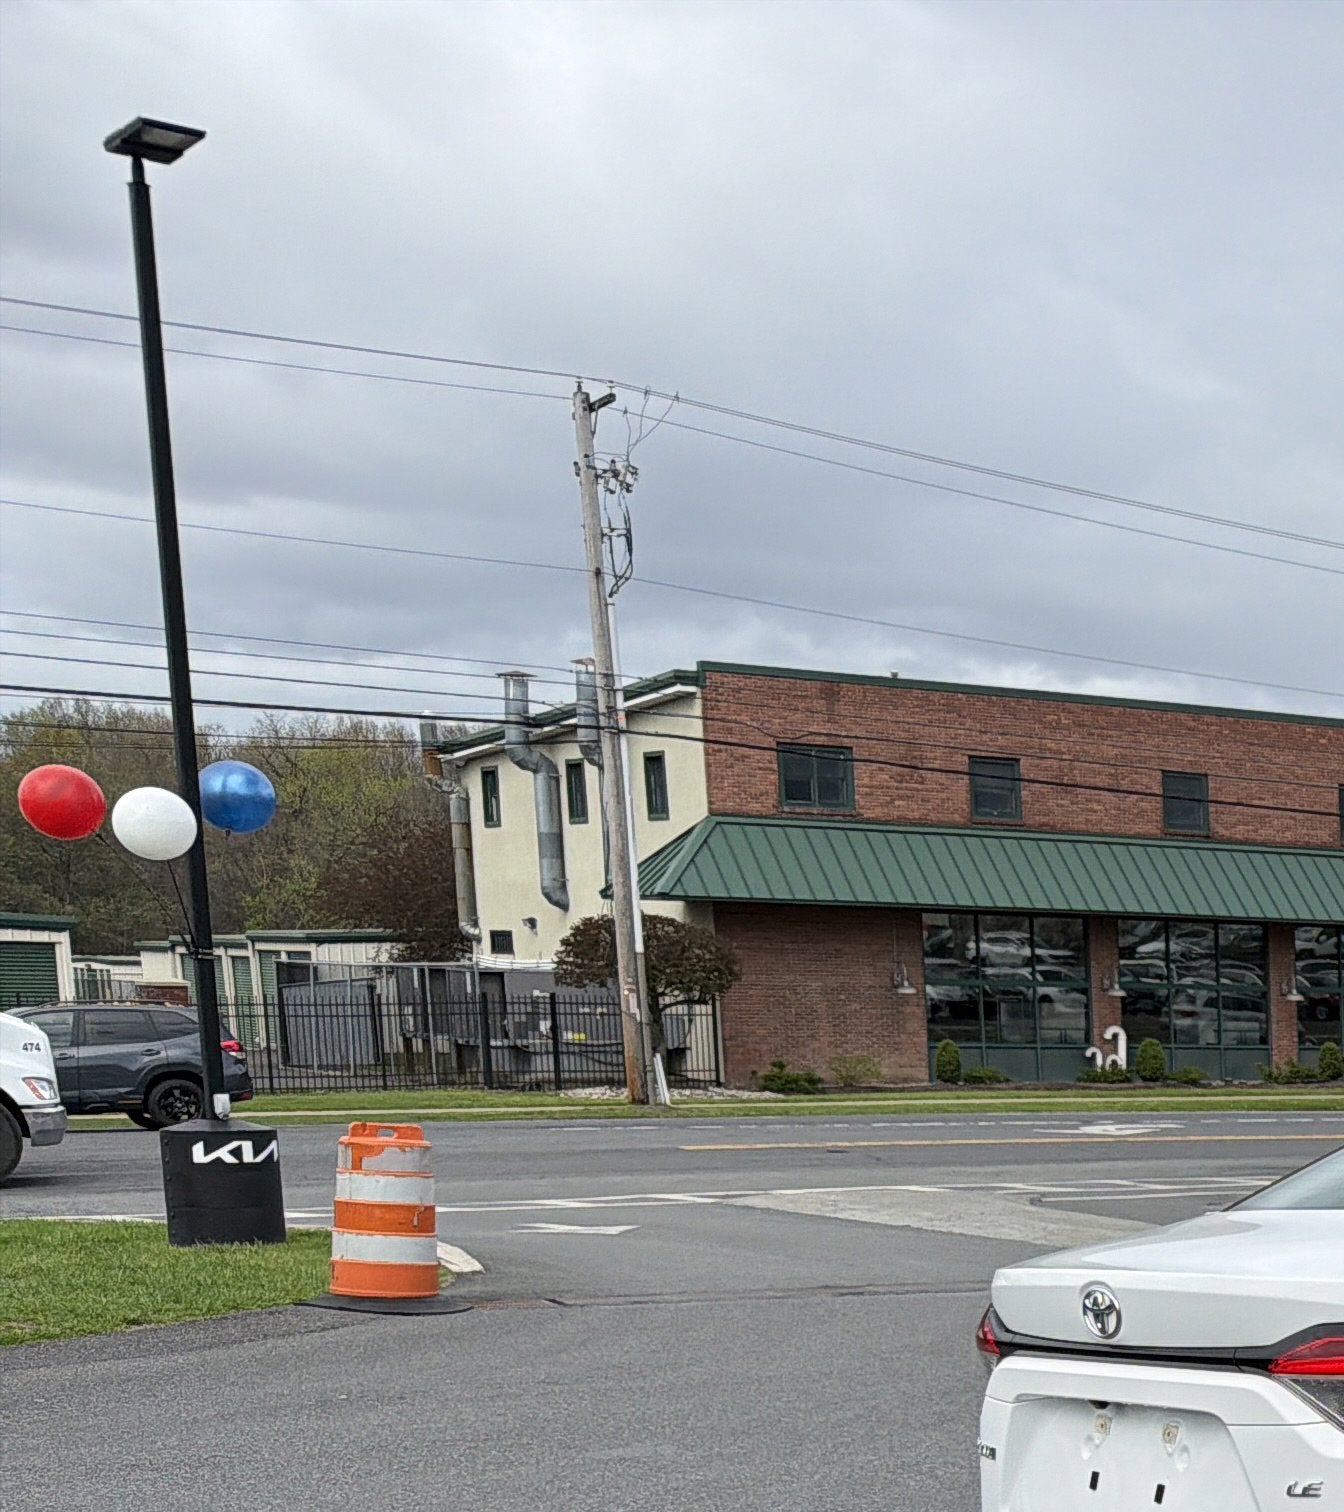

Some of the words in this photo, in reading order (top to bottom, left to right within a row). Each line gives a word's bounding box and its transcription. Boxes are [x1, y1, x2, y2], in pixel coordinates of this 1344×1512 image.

[22, 1042, 41, 1052] 474
[192, 1140, 278, 1164] KIA
[1286, 1481, 1324, 1498] LE
